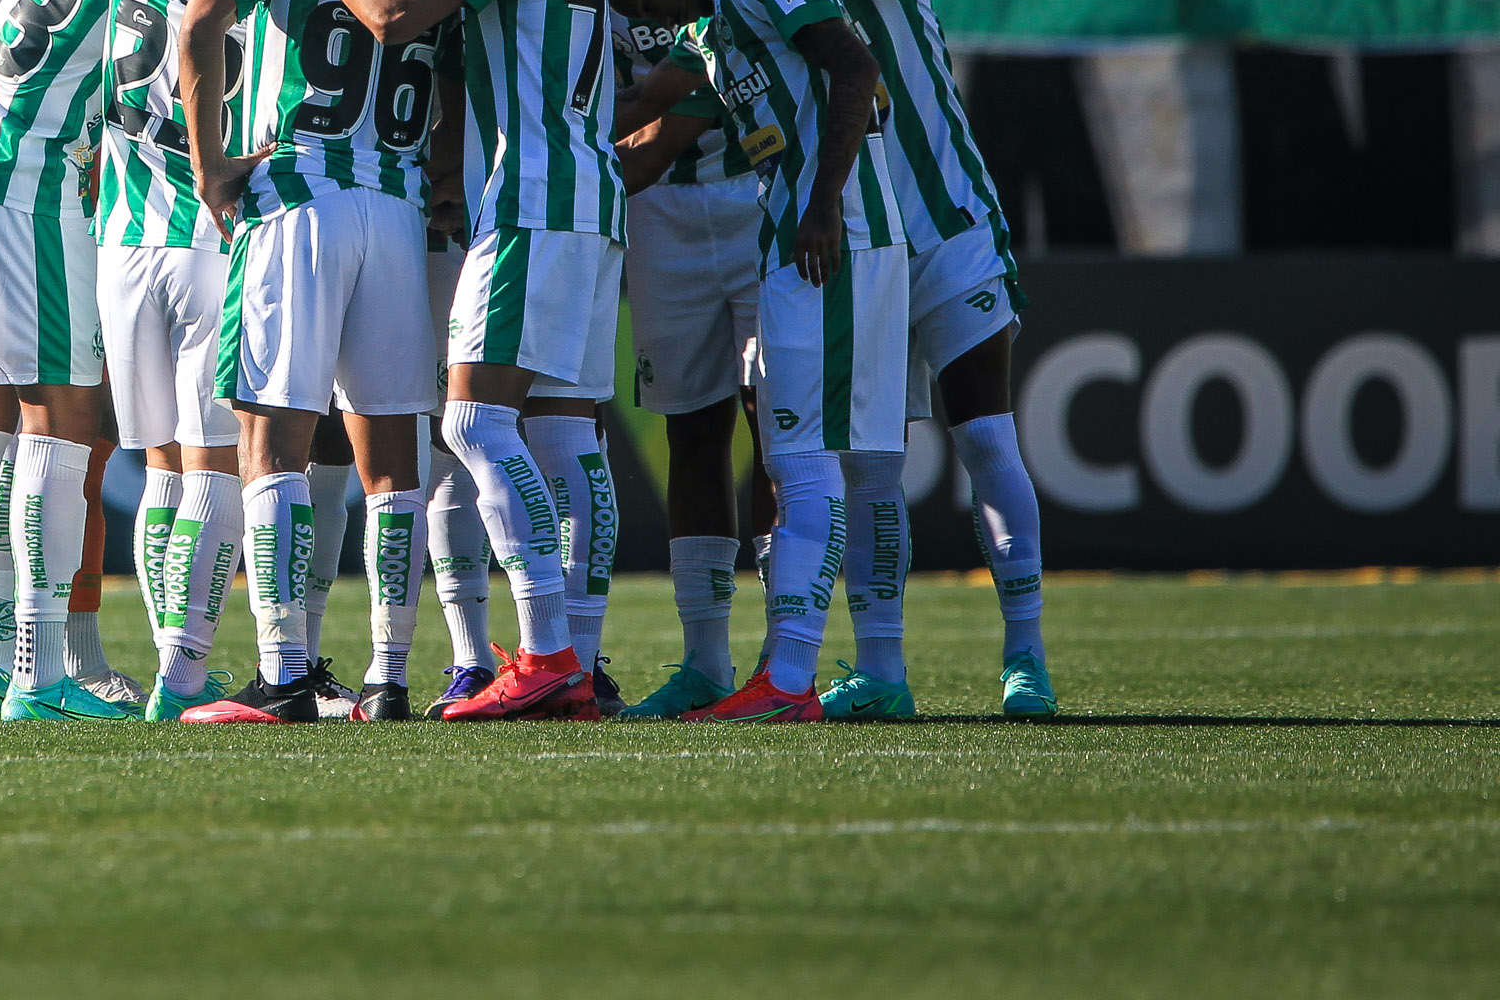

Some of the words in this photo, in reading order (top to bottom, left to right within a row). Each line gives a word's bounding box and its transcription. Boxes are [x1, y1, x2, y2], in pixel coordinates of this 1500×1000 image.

[291, 0, 435, 153] 96
[906, 330, 1500, 517] COO
[290, 523, 314, 611] ROSOCKS
[380, 526, 409, 606] ROSOCKS
[590, 467, 614, 580] PROSOCKS
[165, 534, 194, 615] PROSOCKS
